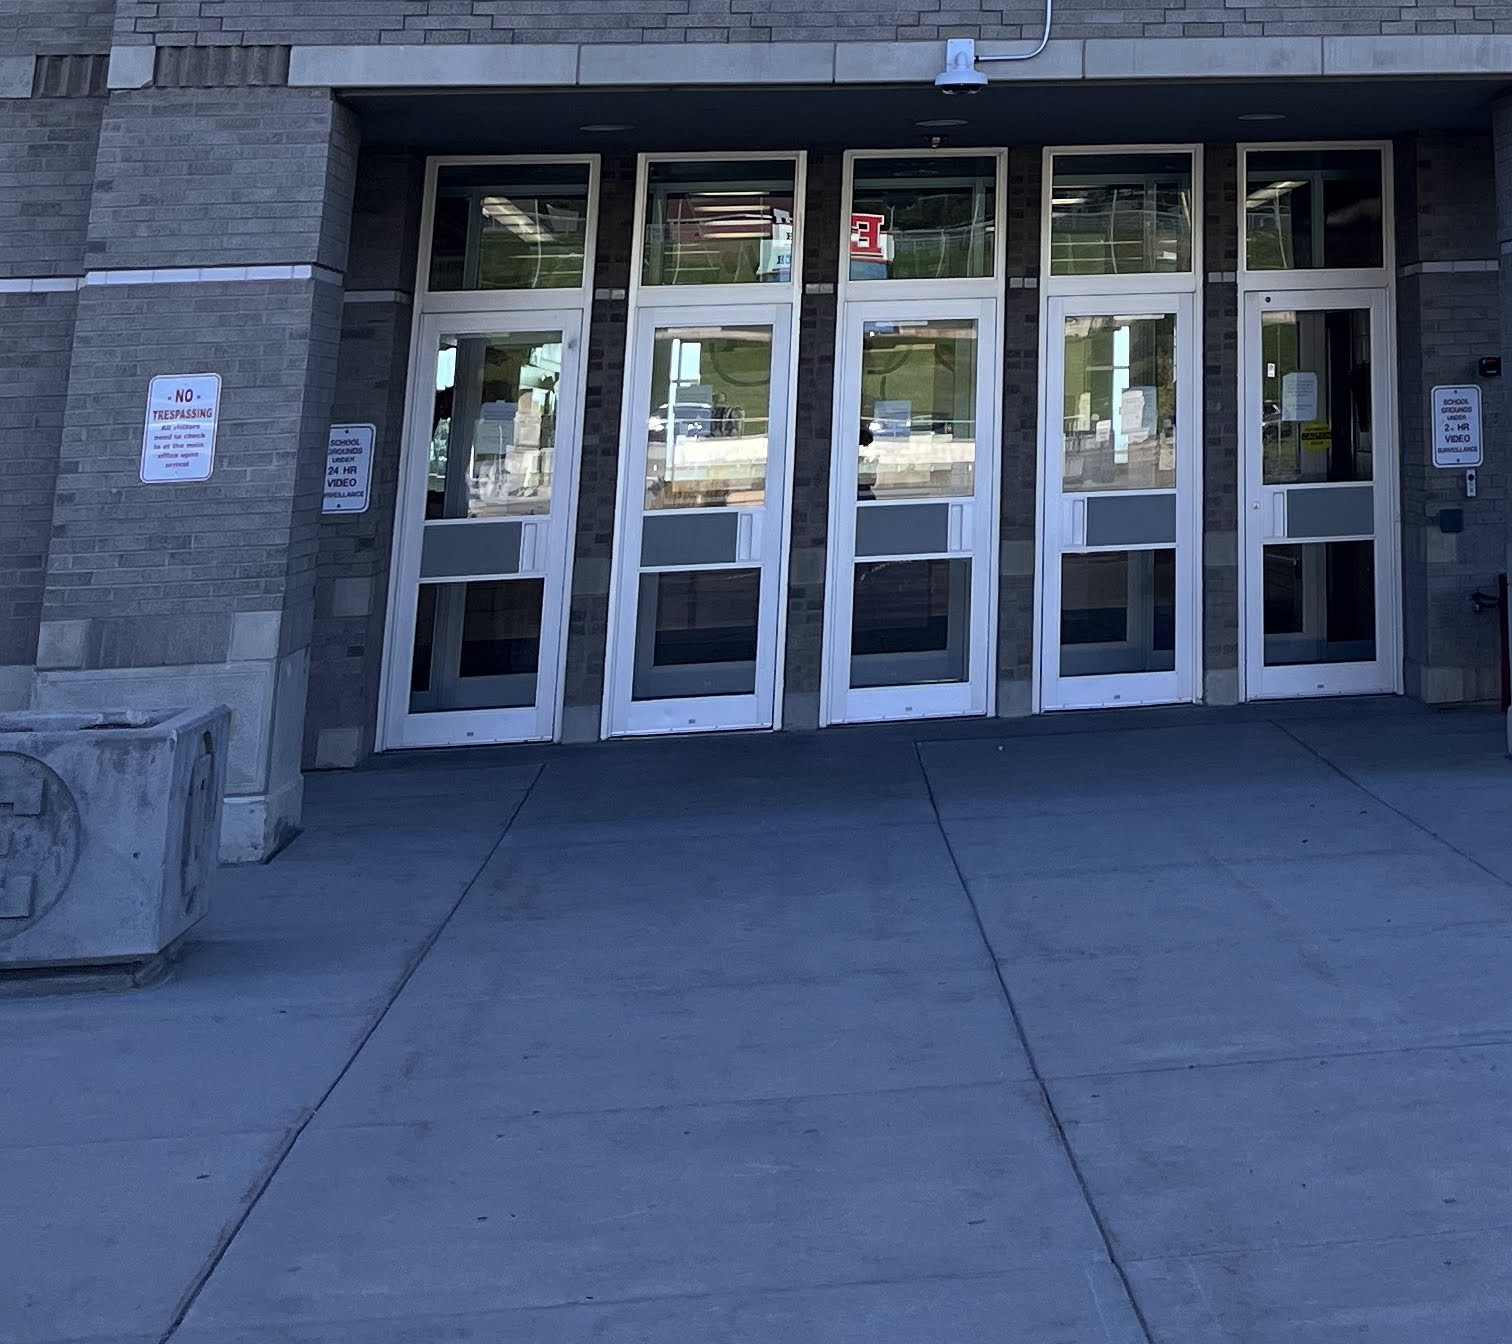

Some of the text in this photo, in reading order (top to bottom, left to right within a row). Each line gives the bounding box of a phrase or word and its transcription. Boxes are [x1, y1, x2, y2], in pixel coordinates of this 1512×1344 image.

[175, 388, 193, 403] NO
[153, 408, 212, 421] TRESPASSING
[1457, 423, 1470, 432] HR
[1444, 434, 1471, 443] VIDEO
[328, 465, 357, 475] 24 HR
[327, 478, 357, 488] VIDEO
